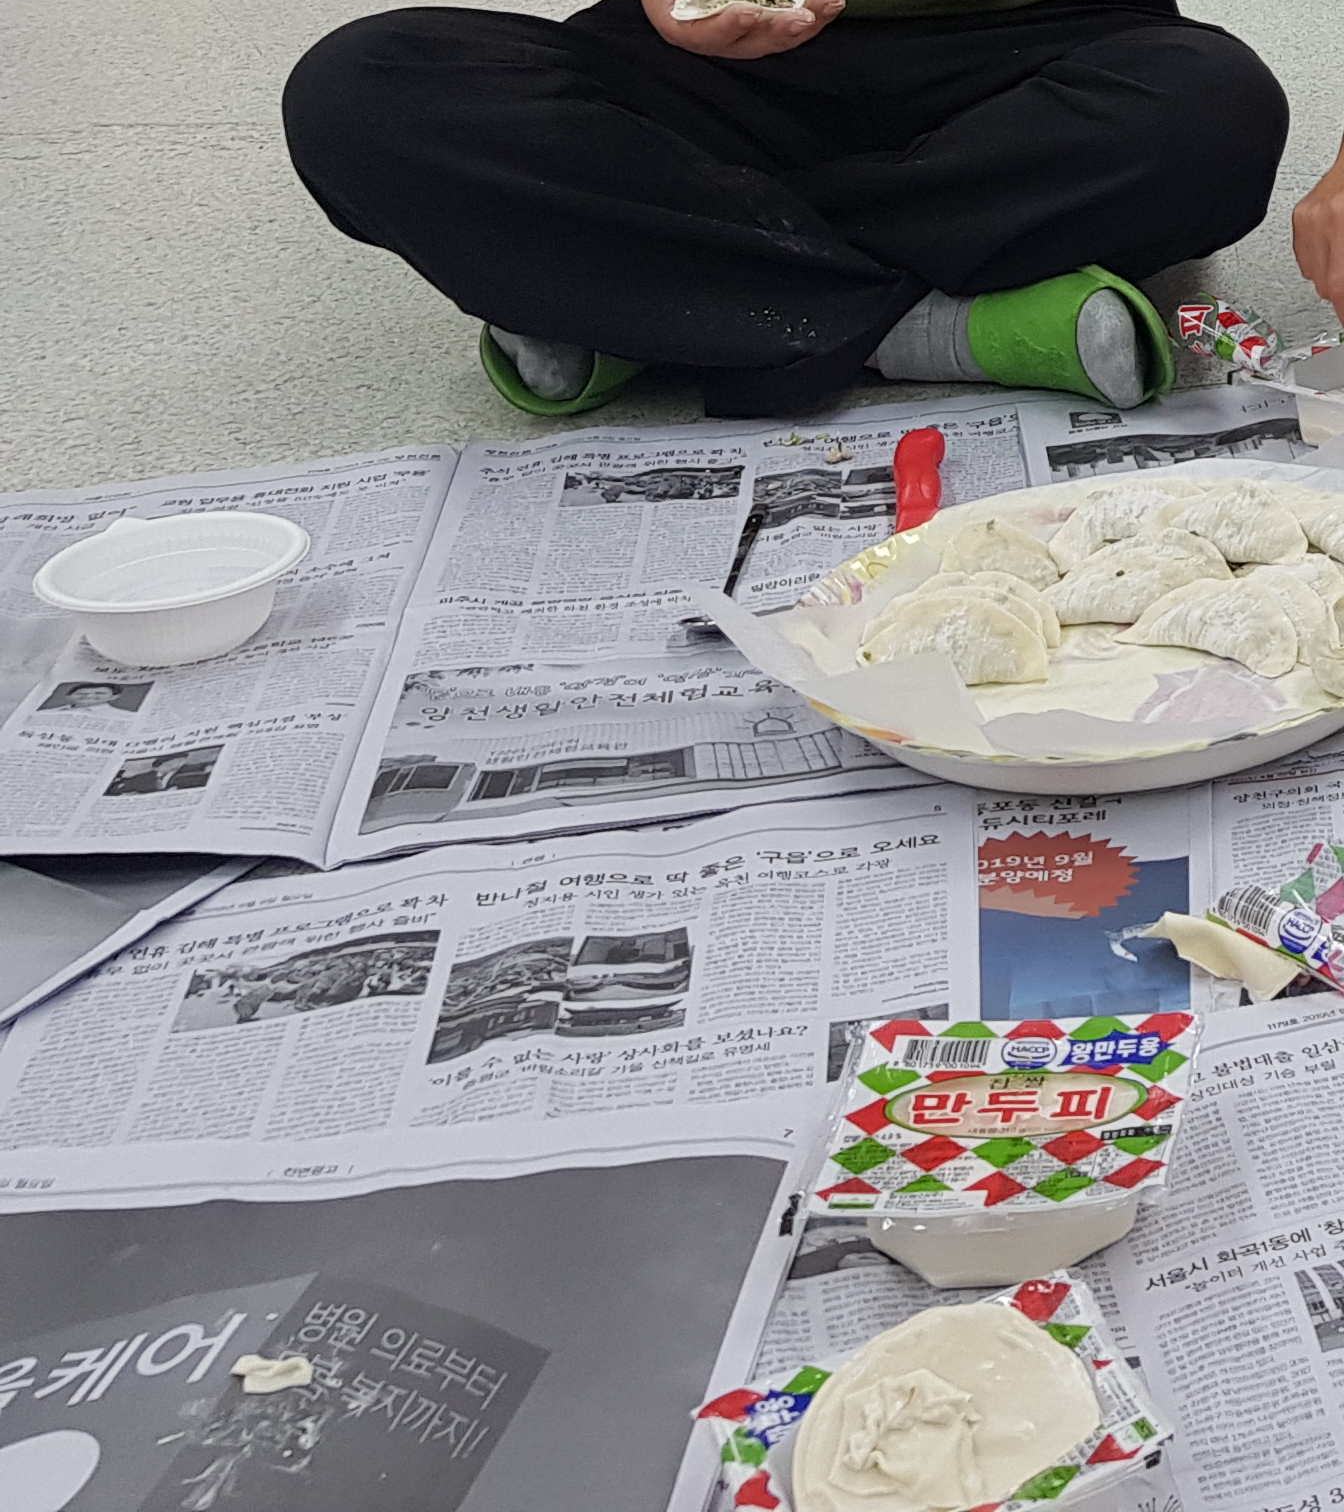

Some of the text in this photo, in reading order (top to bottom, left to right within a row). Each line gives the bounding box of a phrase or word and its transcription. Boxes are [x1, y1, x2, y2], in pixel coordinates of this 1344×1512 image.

[474, 879, 549, 908] 반나절
[559, 872, 655, 886] 여행으로
[666, 870, 691, 884] 딱
[699, 855, 746, 879] 좋은
[869, 833, 941, 855] 오세요
[1053, 851, 1095, 867] 9월
[585, 887, 620, 900] 시인
[269, 894, 449, 937] 프로그램으로 차
[1302, 1010, 1336, 1023] 2019년
[481, 1056, 503, 1069] 수
[513, 1048, 555, 1065] 없는
[711, 1024, 809, 1046] 보셨나요?
[610, 1041, 772, 1075] 가을 산책길로 유명세
[1011, 1045, 1050, 1055] HACCP
[1069, 1036, 1161, 1064] 왕만두용
[1210, 1050, 1295, 1077] 불법대출
[1190, 1073, 1256, 1102] 상인대상
[1263, 1068, 1297, 1082] 기승
[1304, 1058, 1337, 1075] 부릴
[911, 1085, 1114, 1126] 만두피
[1145, 1256, 1210, 1291] 서울시
[1216, 1227, 1312, 1264] 화곡1동에
[1250, 1255, 1288, 1273] 개선
[1293, 1243, 1328, 1263] 사업
[297, 1300, 509, 1412] 병원 의료부터
